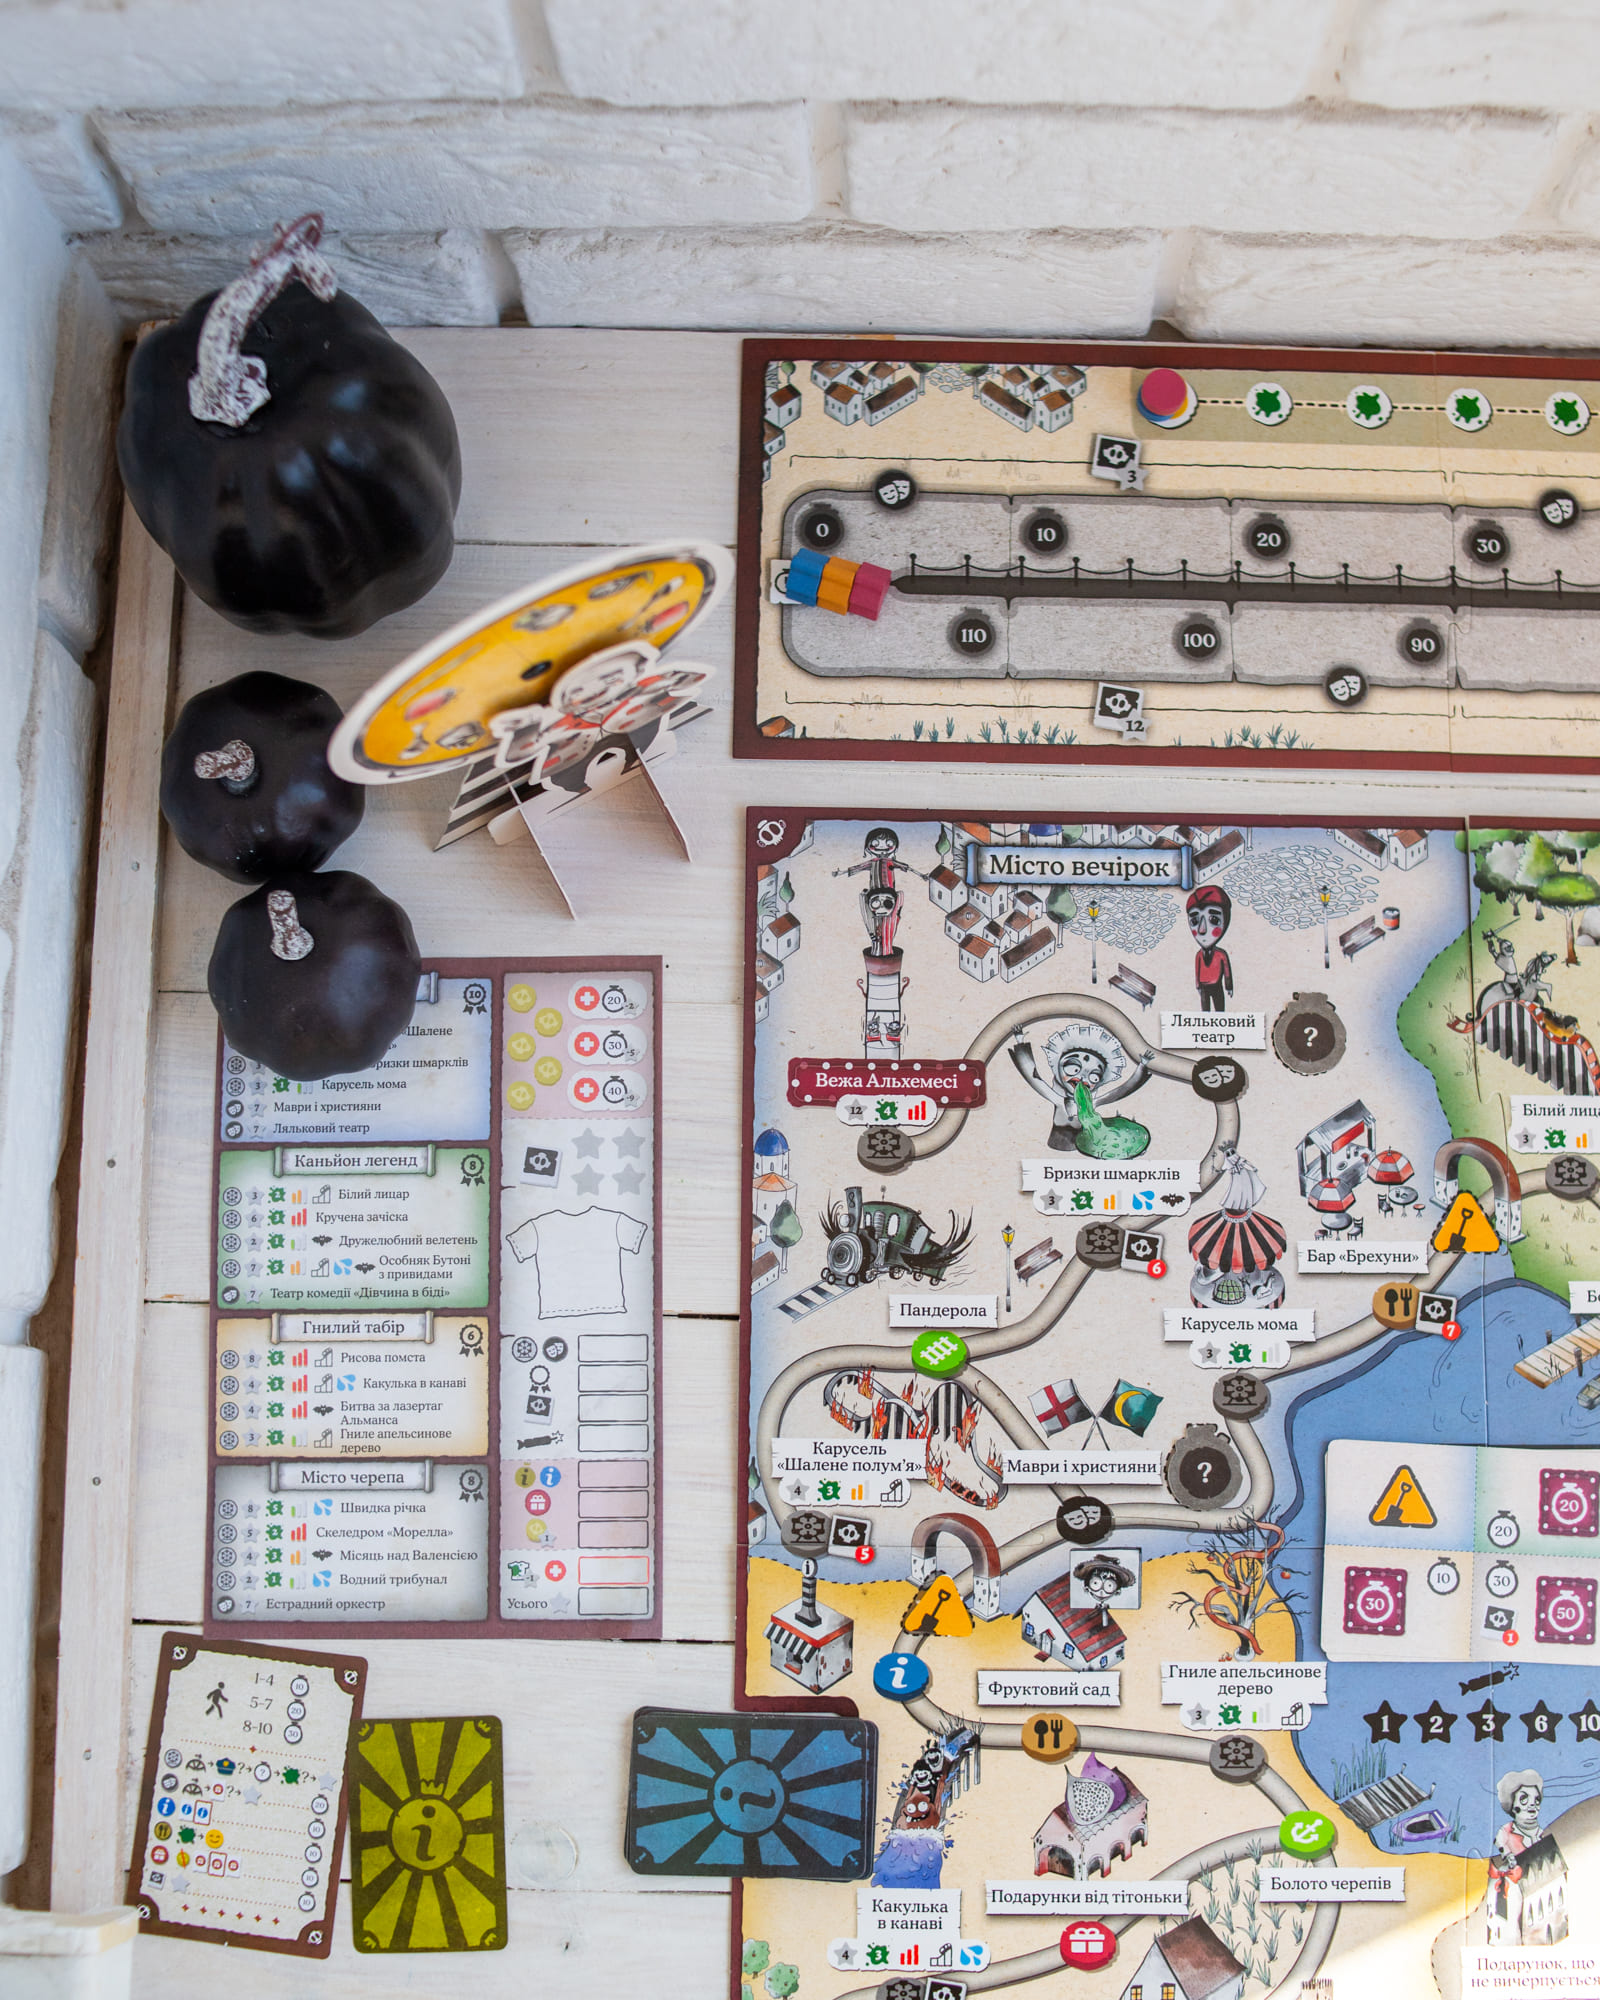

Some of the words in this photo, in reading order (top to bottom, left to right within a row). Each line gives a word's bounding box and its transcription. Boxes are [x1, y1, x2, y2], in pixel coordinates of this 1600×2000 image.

[1127, 470, 1137, 483] 3
[816, 523, 830, 538] 0
[1036, 527, 1057, 542] 10
[1256, 532, 1282, 547] 20
[1476, 538, 1501, 554] 30
[960, 628, 988, 643] 110
[1183, 632, 1216, 648] 100
[1410, 637, 1436, 654] 90
[1125, 719, 1145, 733] 12
[990, 855, 1065, 875] Місто
[1071, 855, 1169, 880] вечірок
[469, 990, 481, 998] 10
[607, 996, 621, 1005] 20
[1170, 1014, 1256, 1030] Ляльковий
[1191, 1030, 1235, 1046] театр
[608, 1041, 622, 1050] 30
[412, 1056, 469, 1069] шмарклів
[255, 1082, 261, 1091] 3
[321, 1079, 374, 1093] Карусель
[376, 1080, 407, 1090] мома
[815, 1072, 863, 1089] Вежа
[865, 1073, 958, 1093] Альхемесі
[608, 1086, 622, 1096] 40
[273, 1102, 312, 1114] Маври
[314, 1100, 318, 1111] і
[320, 1102, 382, 1114] християни
[849, 1105, 863, 1115] 12
[883, 1106, 892, 1116] 4
[1522, 1103, 1566, 1117] Білий
[272, 1122, 336, 1134] Ляльковий
[339, 1123, 370, 1135] театр
[1522, 1134, 1529, 1144] 3
[1552, 1134, 1560, 1143] 2
[294, 1154, 360, 1168] Каньйон
[364, 1155, 418, 1169] легенд
[469, 1161, 476, 1170] 8
[1043, 1166, 1100, 1183] Бризки
[1103, 1167, 1180, 1183] шмарклів
[338, 1188, 371, 1200] Білий
[374, 1190, 410, 1203] лицар
[1048, 1195, 1055, 1206] 3
[1079, 1196, 1088, 1205] 2
[251, 1215, 258, 1223] 6
[316, 1211, 364, 1225] Кручена
[366, 1212, 409, 1223] зачіска
[339, 1235, 423, 1249] Дружелюбний
[425, 1235, 478, 1246] велетень
[251, 1263, 257, 1272] 7
[379, 1255, 430, 1266] Особняк
[433, 1254, 471, 1268] Бутоні
[1307, 1249, 1336, 1265] Бар
[1339, 1249, 1420, 1266] «Брехуни»
[379, 1272, 385, 1280] з
[387, 1269, 453, 1281] привидами
[1152, 1263, 1162, 1275] 6
[270, 1287, 304, 1302] Театр
[306, 1288, 351, 1300] комедії
[354, 1287, 409, 1300] «Дівчина
[412, 1289, 418, 1297] в
[421, 1286, 450, 1299] біді»
[900, 1303, 987, 1318] Пандерола
[303, 1321, 361, 1334] Гнилий
[364, 1320, 405, 1337] табір
[1181, 1317, 1254, 1334] Карусель
[1258, 1319, 1298, 1331] мома
[1446, 1324, 1456, 1338] 7
[467, 1331, 474, 1340] 6
[249, 1354, 255, 1363] 8
[340, 1352, 382, 1363] Рисова
[384, 1353, 426, 1363] помста
[1206, 1348, 1213, 1359] 3
[1238, 1349, 1245, 1358] 1
[248, 1381, 255, 1389] 4
[363, 1378, 417, 1391] Какулька
[419, 1380, 426, 1388] в
[428, 1378, 467, 1388] канаві
[248, 1406, 255, 1414] 4
[340, 1401, 376, 1412] Битва
[379, 1403, 392, 1412] за
[394, 1402, 443, 1414] лазертаг
[340, 1415, 399, 1427] Альманса
[249, 1433, 255, 1442] 3
[340, 1428, 375, 1440] Гниле
[377, 1430, 452, 1442] апельсинове
[340, 1443, 381, 1455] дерево
[813, 1441, 887, 1458] Карусель
[777, 1457, 849, 1473] «Шалене
[1007, 1460, 1061, 1475] Маври
[1063, 1459, 1069, 1473] і
[1072, 1462, 1157, 1475] християни
[301, 1470, 347, 1484] Місто
[350, 1472, 404, 1486] черепа
[467, 1476, 475, 1486] 8
[793, 1485, 802, 1496] 4
[826, 1485, 834, 1496] 3
[340, 1502, 391, 1514] Швидка
[394, 1501, 426, 1515] річка
[1559, 1500, 1579, 1513] 20
[316, 1527, 384, 1539] Скеледром
[387, 1527, 454, 1539] «Морелла»
[1494, 1526, 1513, 1537] 20
[339, 1550, 384, 1562] Місяць
[387, 1551, 410, 1562] над
[412, 1550, 478, 1562] Валенсією
[860, 1547, 870, 1560] 5
[339, 1573, 386, 1586] Водний
[388, 1574, 448, 1586] трибунал
[1436, 1573, 1451, 1584] 10
[1493, 1575, 1511, 1587] 30
[266, 1597, 333, 1611] Естрадний
[336, 1599, 386, 1611] оркестр
[507, 1599, 548, 1609] Усього
[1365, 1598, 1386, 1611] 30
[1556, 1608, 1576, 1621] 50
[1507, 1633, 1514, 1644] 1
[1168, 1664, 1217, 1679] Гниле
[1220, 1666, 1322, 1680] апельсинове
[988, 1681, 1079, 1698] Фруктовий
[1082, 1684, 1111, 1697] сад
[1217, 1683, 1273, 1697] дерево
[1195, 1710, 1202, 1721] 3
[1227, 1709, 1234, 1720] 1
[1380, 1715, 1390, 1732] 1
[1429, 1715, 1444, 1733] 2
[1481, 1715, 1496, 1732] 3
[1534, 1714, 1548, 1733] 6
[1579, 1713, 1600, 1732] 10
[1271, 1876, 1328, 1891] Болото
[1331, 1877, 1392, 1894] черепів
[991, 1889, 1082, 1906] Подарунки
[1085, 1889, 1108, 1904] від
[1115, 1889, 1183, 1904] тітоньки
[871, 1898, 949, 1916] Какулька
[877, 1919, 886, 1930] в
[890, 1917, 943, 1931] канаві
[841, 1950, 850, 1960] 4
[873, 1949, 883, 1961] 3
[1477, 1957, 1568, 1974] Подарунок,
[1571, 1959, 1595, 1970] що
